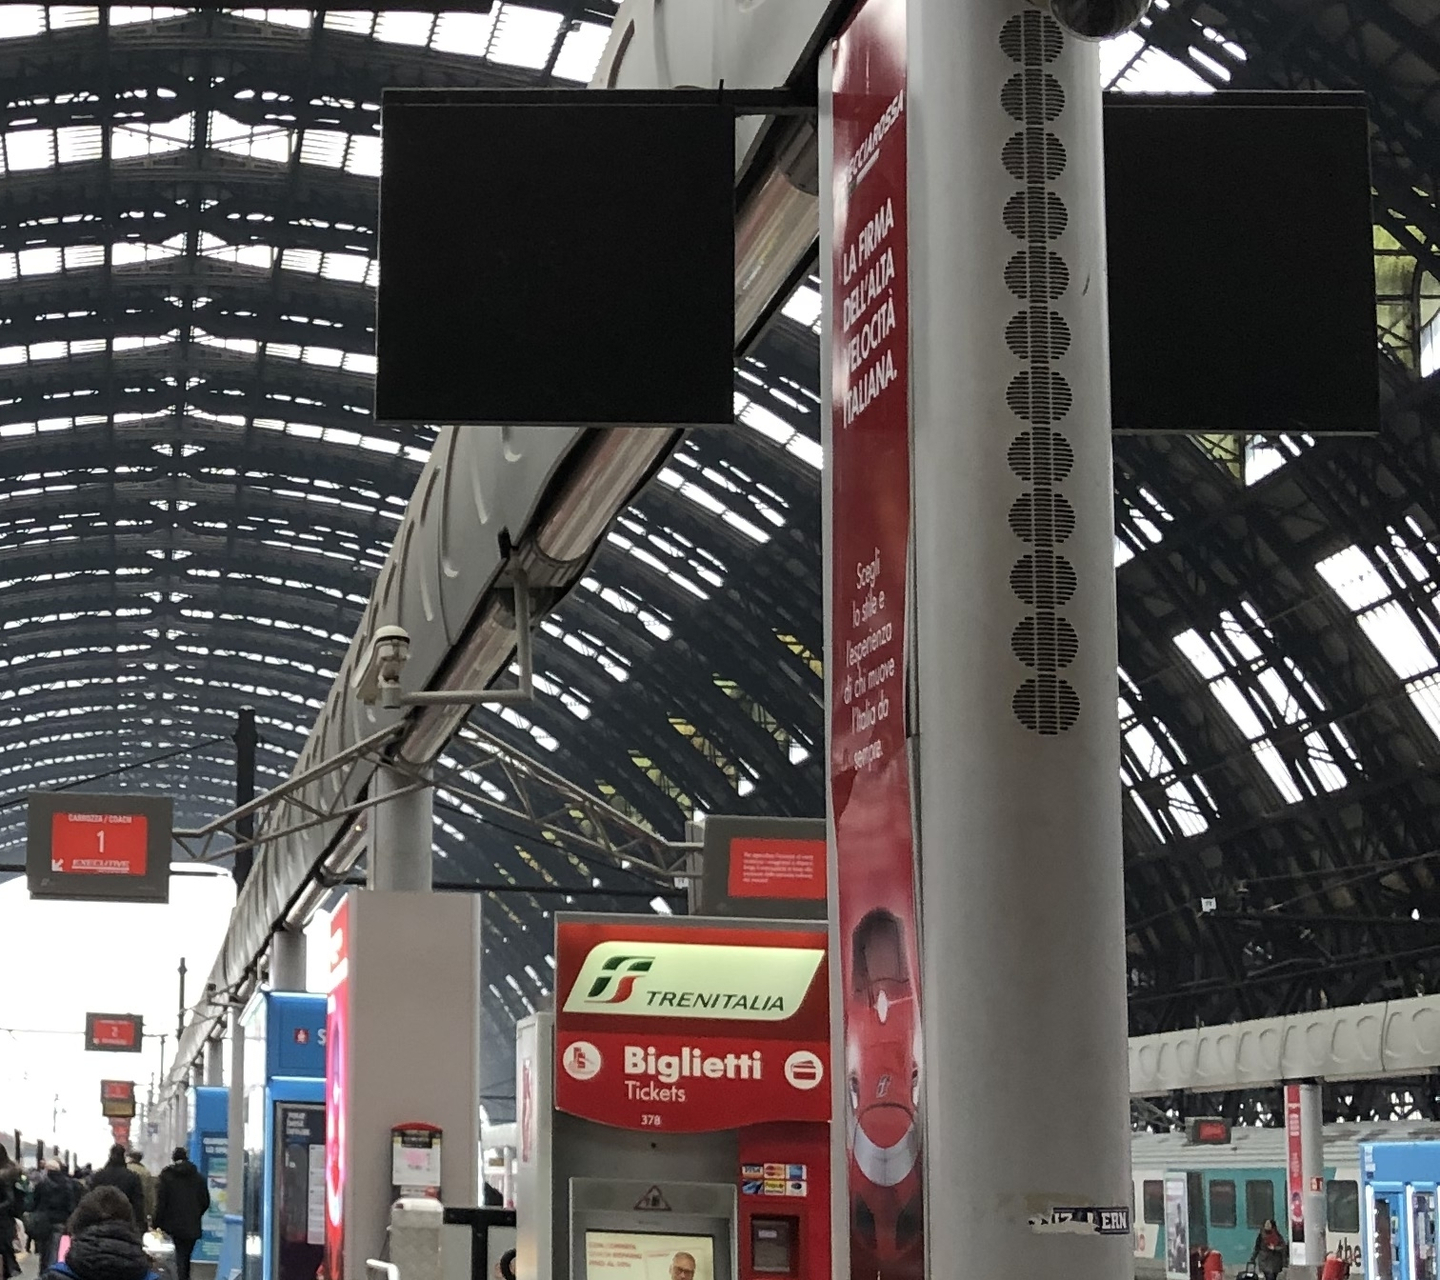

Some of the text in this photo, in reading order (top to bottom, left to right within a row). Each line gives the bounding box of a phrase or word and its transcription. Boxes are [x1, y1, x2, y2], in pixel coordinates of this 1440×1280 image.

[844, 197, 895, 286] LA FIRMA
[843, 246, 896, 334] DELL'ALTA
[843, 288, 896, 373] VELOCITÀ
[843, 349, 898, 429] ITALIANA.
[856, 546, 881, 590] Scegli
[868, 658, 895, 690] muove
[877, 689, 890, 721] da
[96, 829, 105, 853] 1
[646, 991, 785, 1012] TRENITALIA
[624, 1045, 762, 1083] Biglietti
[624, 1081, 687, 1102] Tickets
